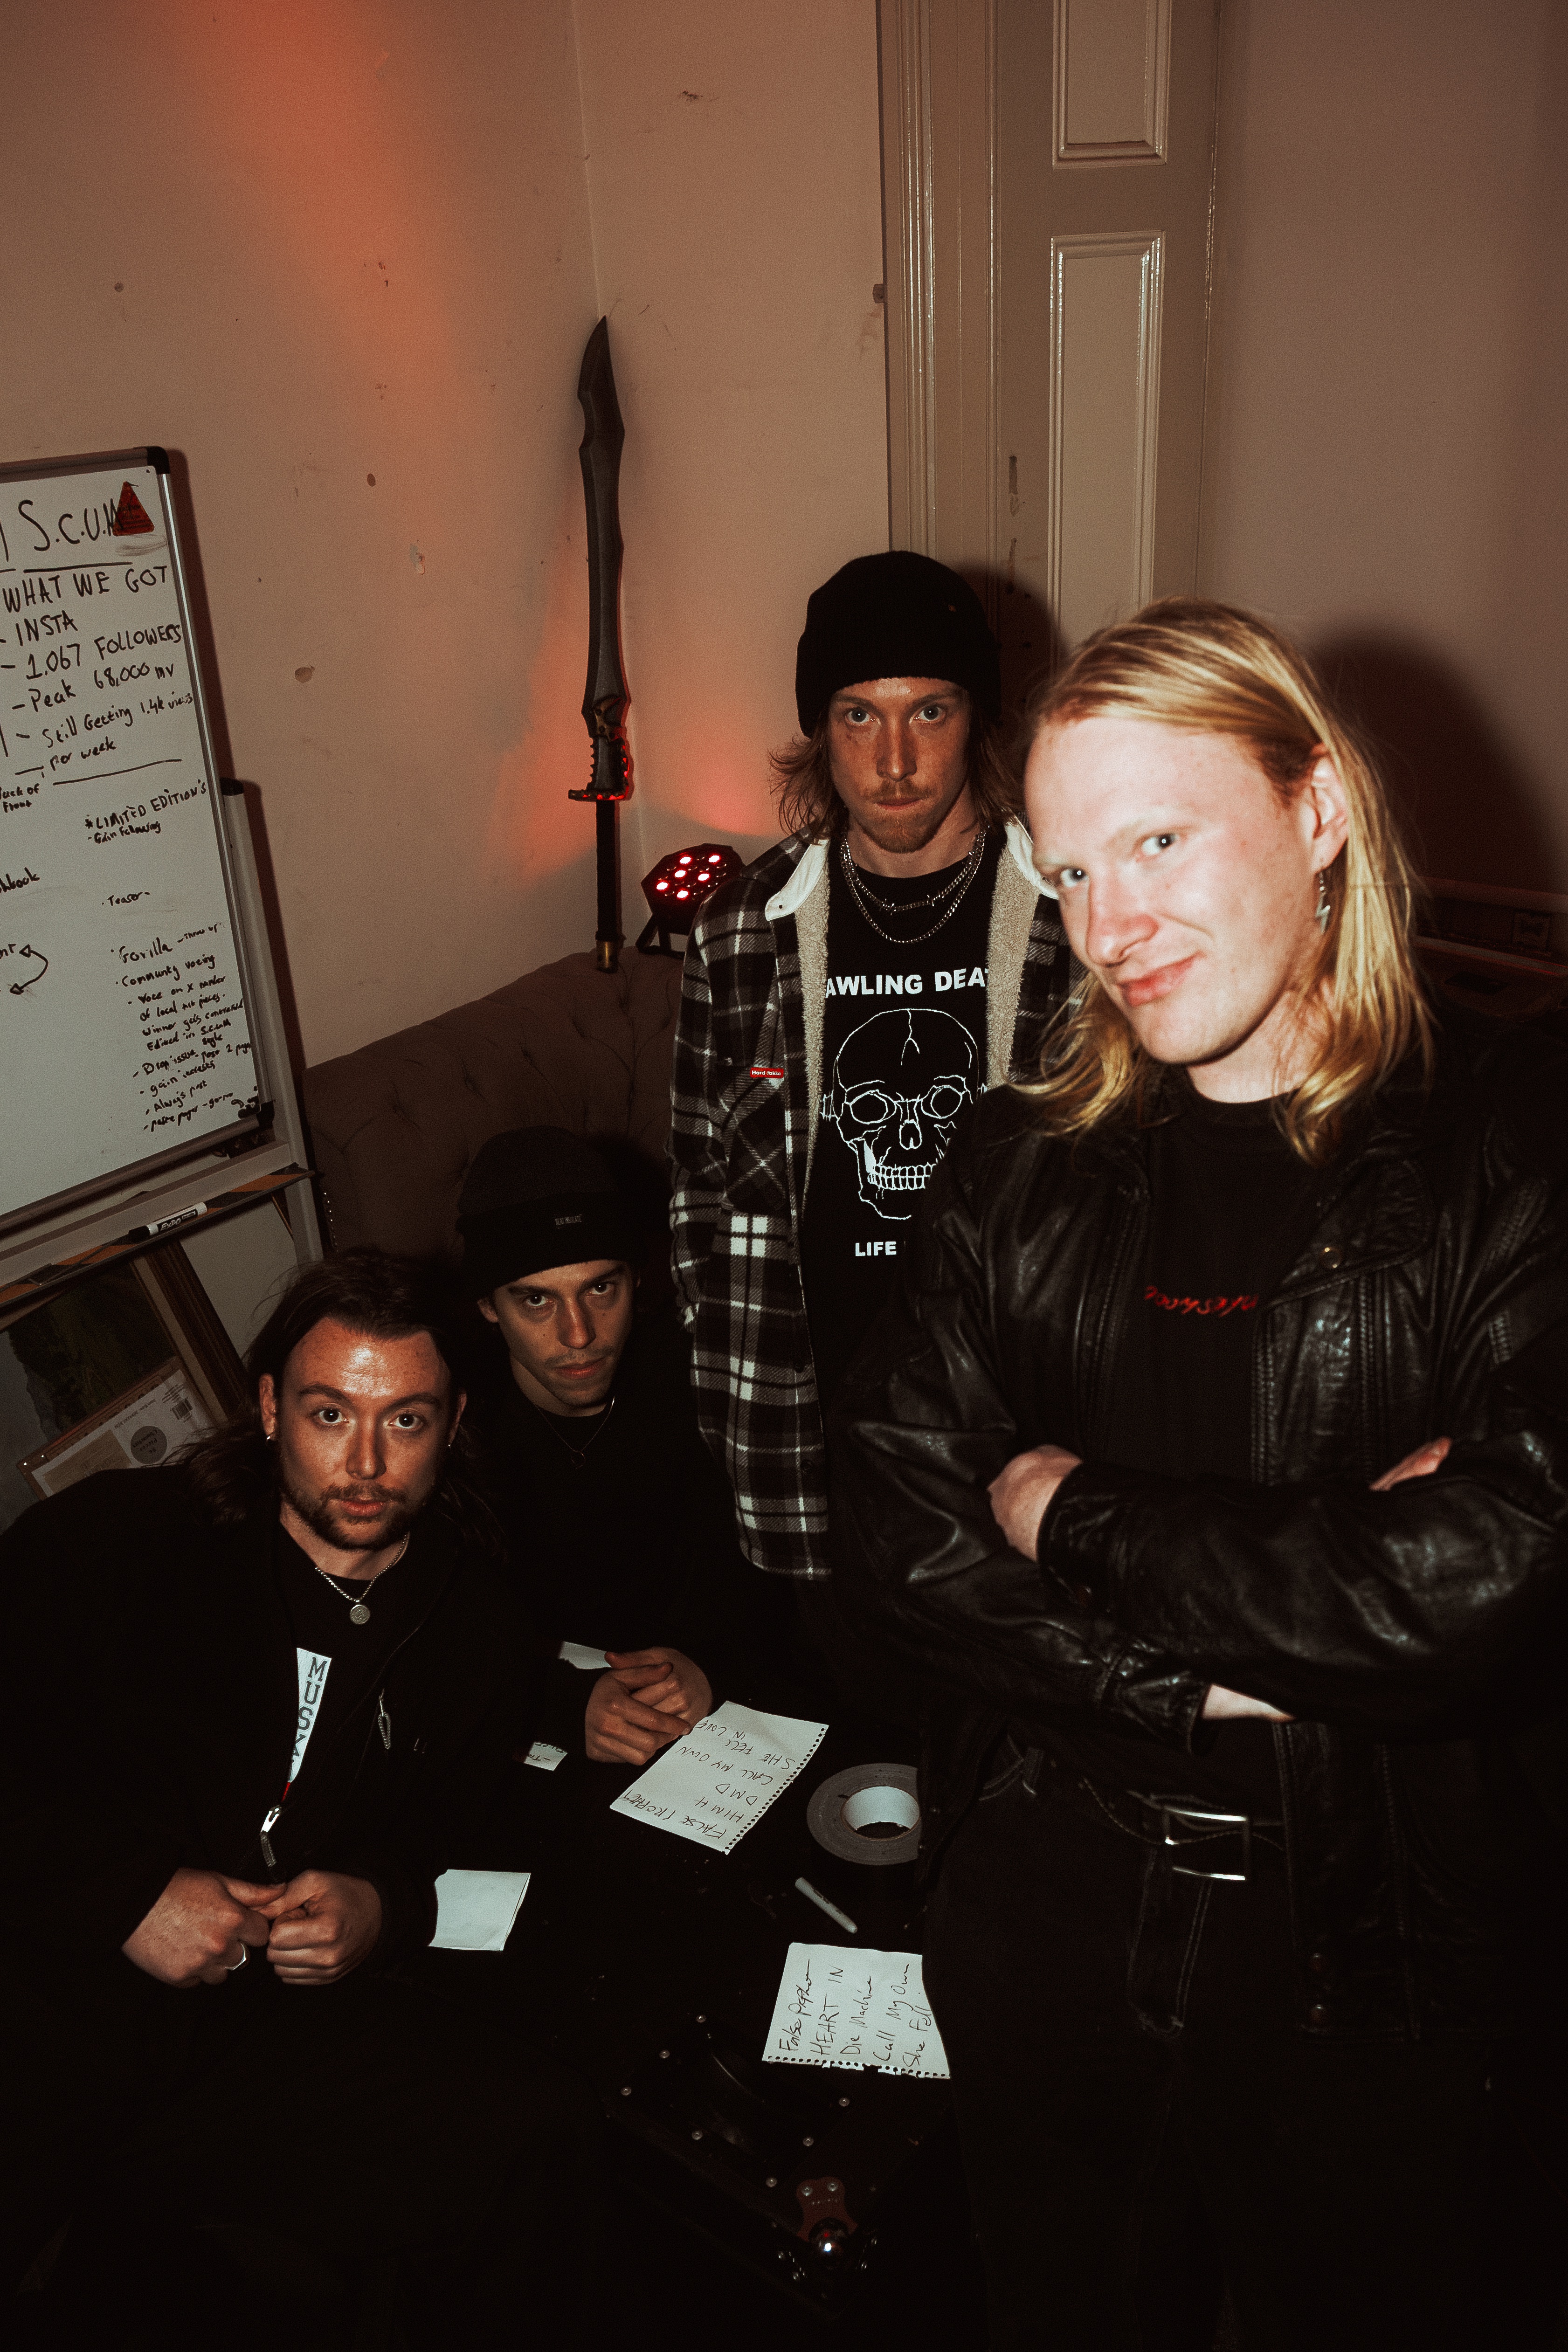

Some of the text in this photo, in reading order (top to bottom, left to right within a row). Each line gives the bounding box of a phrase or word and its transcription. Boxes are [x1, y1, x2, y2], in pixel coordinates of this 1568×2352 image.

[2, 566, 167, 613] WHAT WE GOT
[16, 610, 78, 646] INSTA
[94, 624, 182, 661] FOLLOWERS
[28, 679, 76, 712] Peak
[94, 662, 150, 689] 68,000
[42, 715, 77, 748] Still
[84, 705, 133, 731] Getting
[81, 736, 117, 759] week
[855, 1241, 897, 1256] LIFE
[734, 1731, 746, 1740] IN
[675, 1746, 774, 1785] CALL MY OWN
[757, 1753, 795, 1770] SHE
[679, 1815, 727, 1839] FALSE
[809, 1965, 843, 2055] HEART IN
[839, 2035, 862, 2055] Die
[873, 2030, 896, 2061] Call
[886, 2000, 914, 2020] My
[902, 2041, 925, 2067] She
